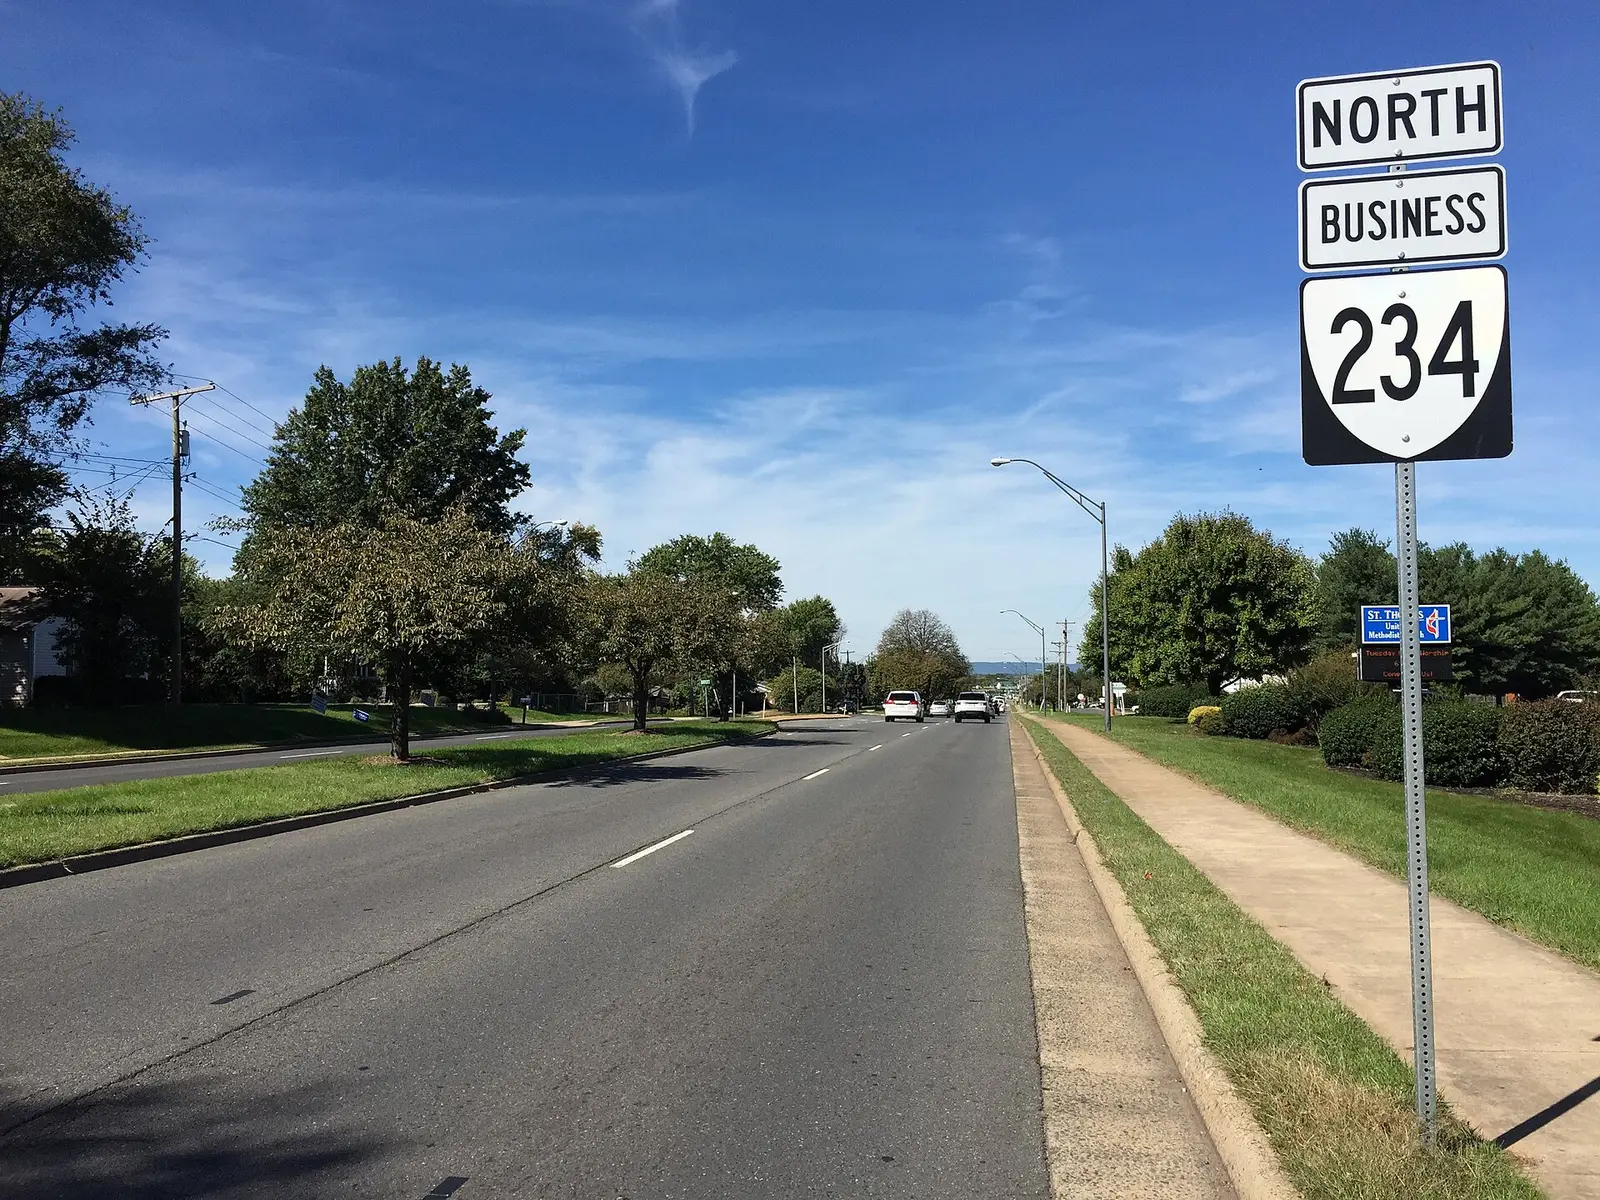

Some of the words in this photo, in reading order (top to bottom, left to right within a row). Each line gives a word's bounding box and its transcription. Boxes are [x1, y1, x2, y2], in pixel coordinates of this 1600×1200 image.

[1312, 84, 1487, 148] NORTH
[1321, 192, 1486, 244] BUSINESS
[1330, 300, 1480, 405] 234
[1368, 630, 1400, 639] Methodist
[1384, 609, 1424, 620] THS
